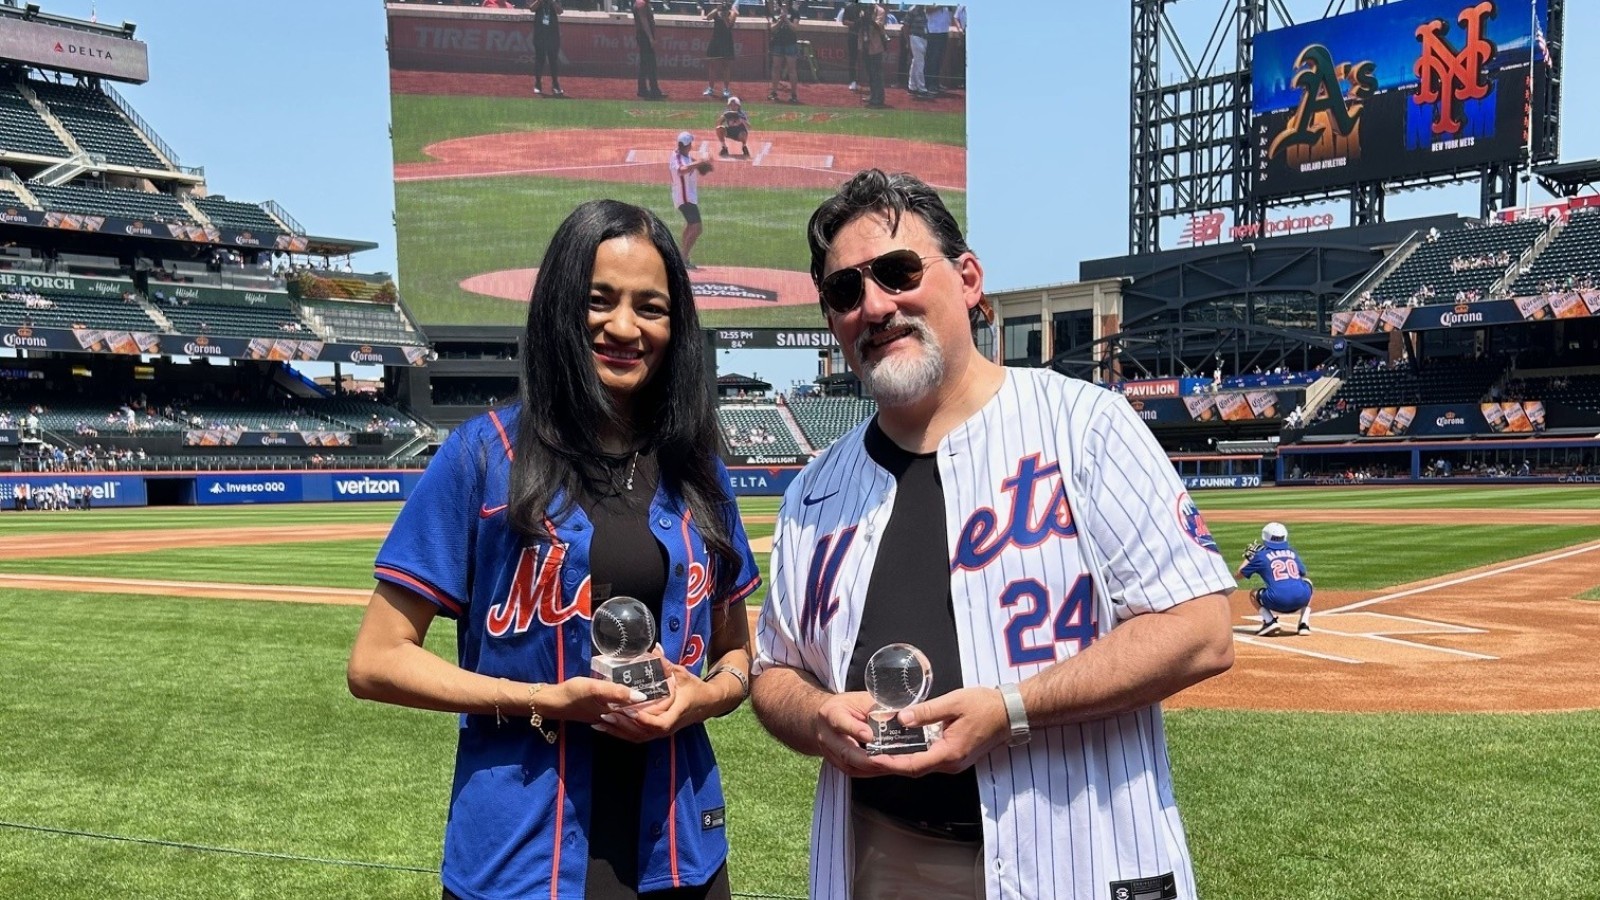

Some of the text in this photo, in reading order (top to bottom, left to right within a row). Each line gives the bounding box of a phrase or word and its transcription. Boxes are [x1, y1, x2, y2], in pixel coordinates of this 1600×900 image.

[414, 26, 481, 50] TIRE
[68, 44, 113, 60] DELTA
[126, 225, 152, 235] Corona
[1229, 213, 1334, 238] new balance
[235, 235, 260, 245] Corona
[20, 275, 75, 290] PORCH
[1440, 311, 1483, 327] Corona
[3, 333, 48, 348] Corona
[776, 333, 840, 347] SAMSUN
[183, 342, 222, 355] Corona
[350, 350, 383, 362] Corona
[1126, 384, 1175, 396] PAVILION
[1436, 417, 1465, 427] Corona
[261, 436, 287, 445] Corona
[226, 481, 285, 492] Invesco QQQ
[336, 477, 400, 493] verizon
[731, 477, 768, 488] ELTA
[1200, 478, 1237, 487] DUNKIN'
[1241, 476, 1260, 487] 370
[1271, 560, 1300, 582] 20
[1000, 572, 1099, 667] 24
